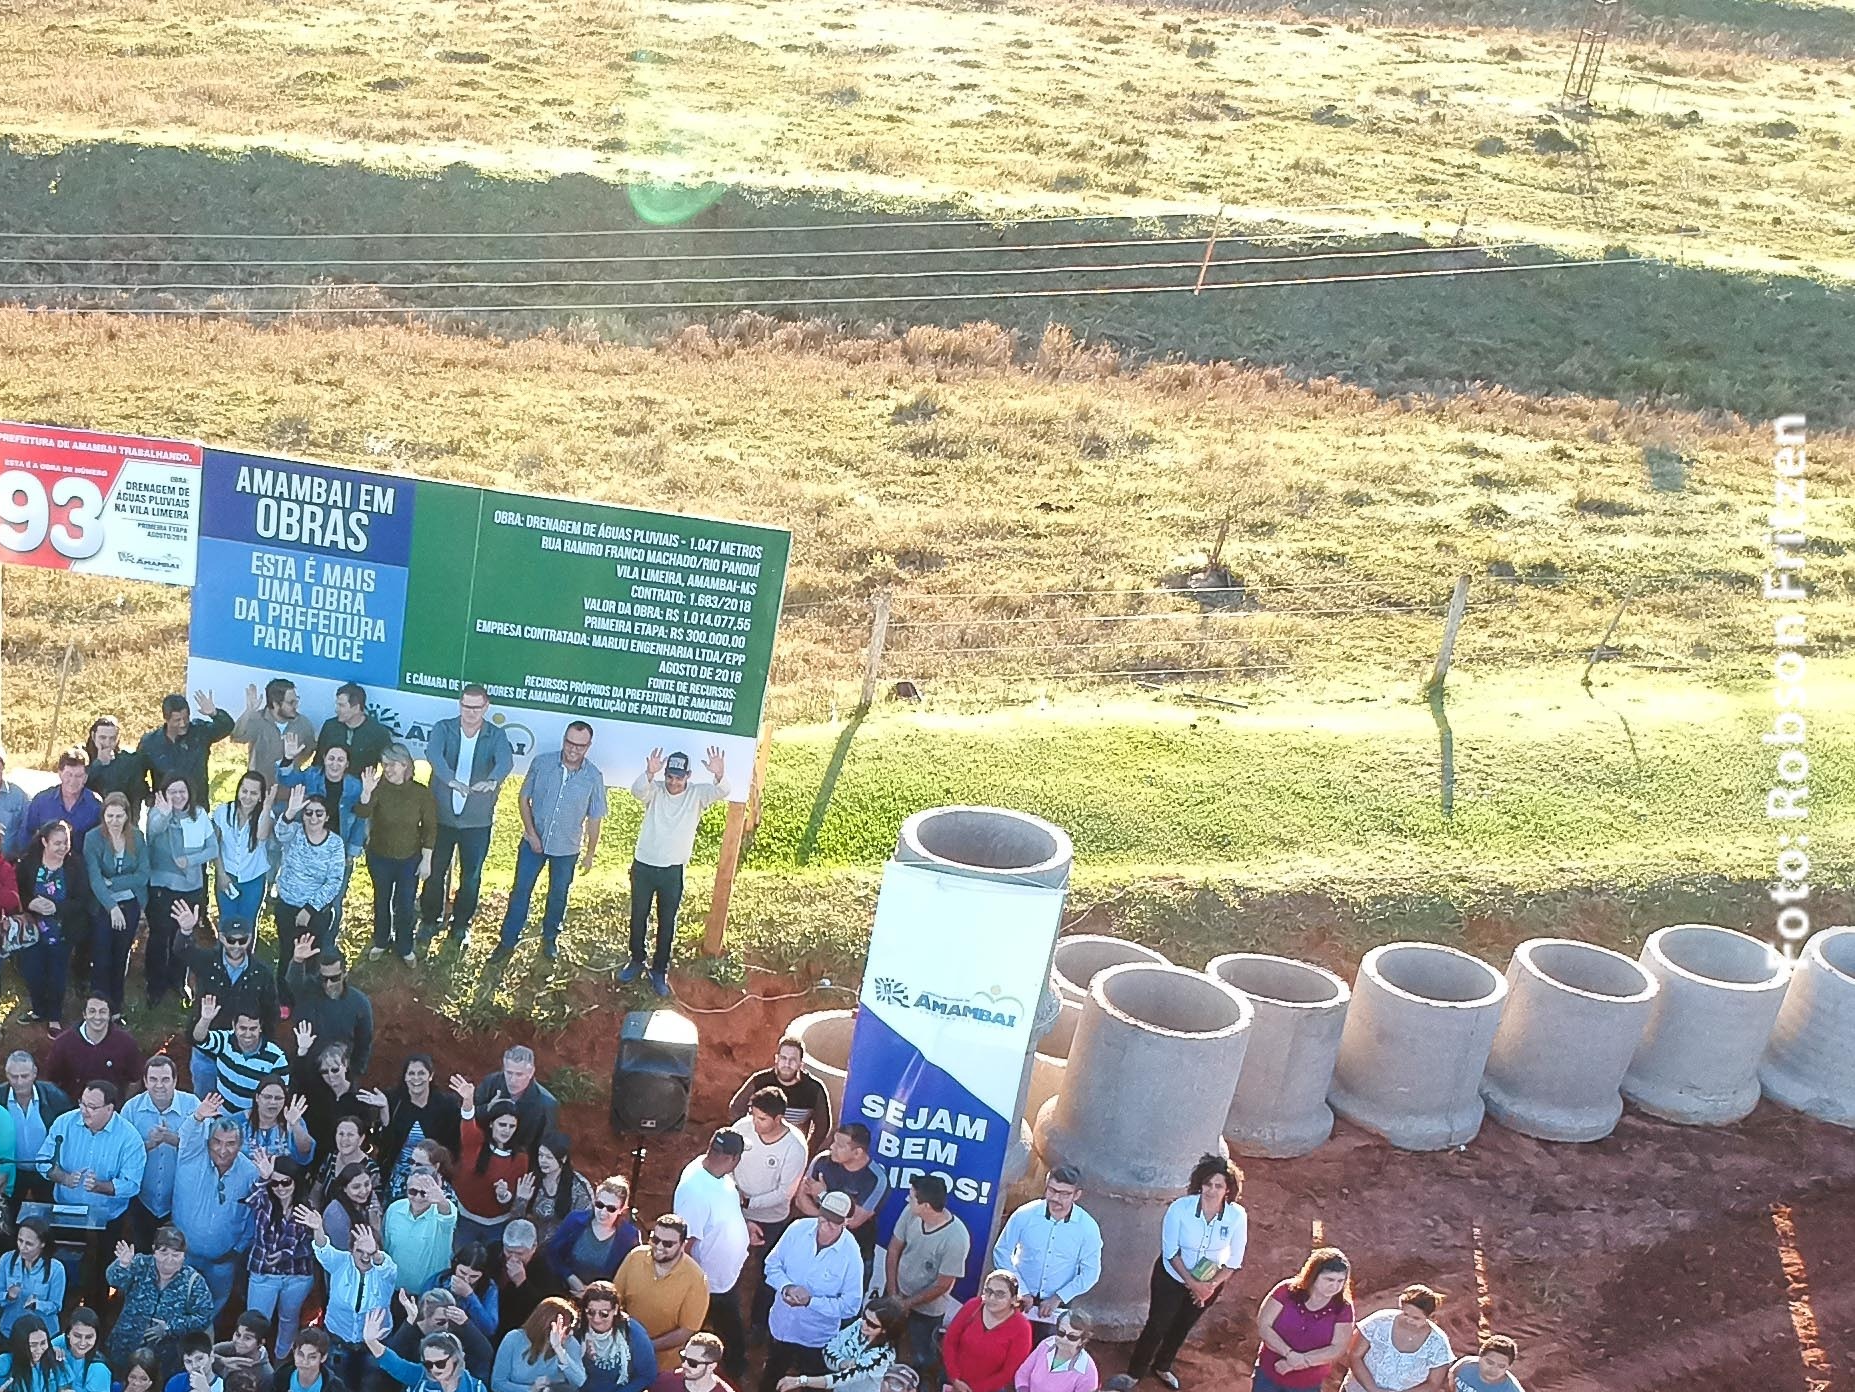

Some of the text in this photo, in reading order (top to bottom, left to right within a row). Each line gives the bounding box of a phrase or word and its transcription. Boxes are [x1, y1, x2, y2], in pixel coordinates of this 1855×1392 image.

[56, 439, 70, 450] DE
[71, 440, 117, 454] AMAMBAI
[119, 445, 192, 462] TRABALHANDO.
[115, 491, 189, 509] ÁGUAS PLUVIAIS
[125, 481, 190, 497] DRENAGEM DE
[235, 466, 394, 515] AMAMBAI EM
[114, 503, 189, 521] NA VILA LIMEIRA
[255, 500, 368, 551] OBRAS
[493, 510, 524, 527] OBRA:
[525, 514, 579, 534] DRENAGEM
[582, 522, 596, 536] DE
[597, 524, 632, 541] ÁGUAS
[633, 529, 679, 547] PLUVIAIS
[689, 536, 719, 553] 1.047
[720, 540, 762, 558] METROS
[250, 552, 375, 591] ESTA É MAIS
[541, 536, 760, 577] RUA RAMIRO FRANCO MACHADO/RIO PANDUÍ
[257, 578, 365, 615] UMA OBRA
[616, 564, 757, 595] VILA LIMEIRA, AMAMBAI-MS
[630, 585, 686, 605] CONTRATO:
[233, 598, 385, 642] DA PREFEITURA
[583, 598, 751, 631] VALOR DA OBRA: R$ 1.014.077,55
[584, 616, 745, 648] PRIMEIRA ETAPA: R$ 300.000,00
[252, 625, 363, 663] PARA VOCÊ
[475, 620, 522, 637] EMPRESA
[523, 626, 590, 646] CONTRATADA:
[630, 639, 693, 659] ENGENHARIA
[695, 647, 746, 665] LTDA/EPP
[647, 678, 736, 700] FONTE DE RECURSOS:
[658, 661, 742, 683] AGOSTO DE 2018
[405, 673, 411, 685] E
[413, 674, 449, 690] CÂMARA
[450, 679, 460, 692] DE
[515, 687, 526, 700] DE
[527, 688, 569, 705] AMAMBAI
[577, 695, 624, 712] DEVOLUÇÃO
[625, 701, 637, 714] DE
[638, 702, 667, 718] PARTE
[668, 706, 681, 719] DO
[681, 708, 732, 726] DUODÉCIMO
[524, 675, 733, 712] RECURSOS PRÓPRIOS DA PREFEITURA DE AMAMBAI
[913, 994, 1016, 1028] AMAMBAI
[861, 1094, 988, 1141] SEJAM
[878, 1131, 958, 1167] BEM
